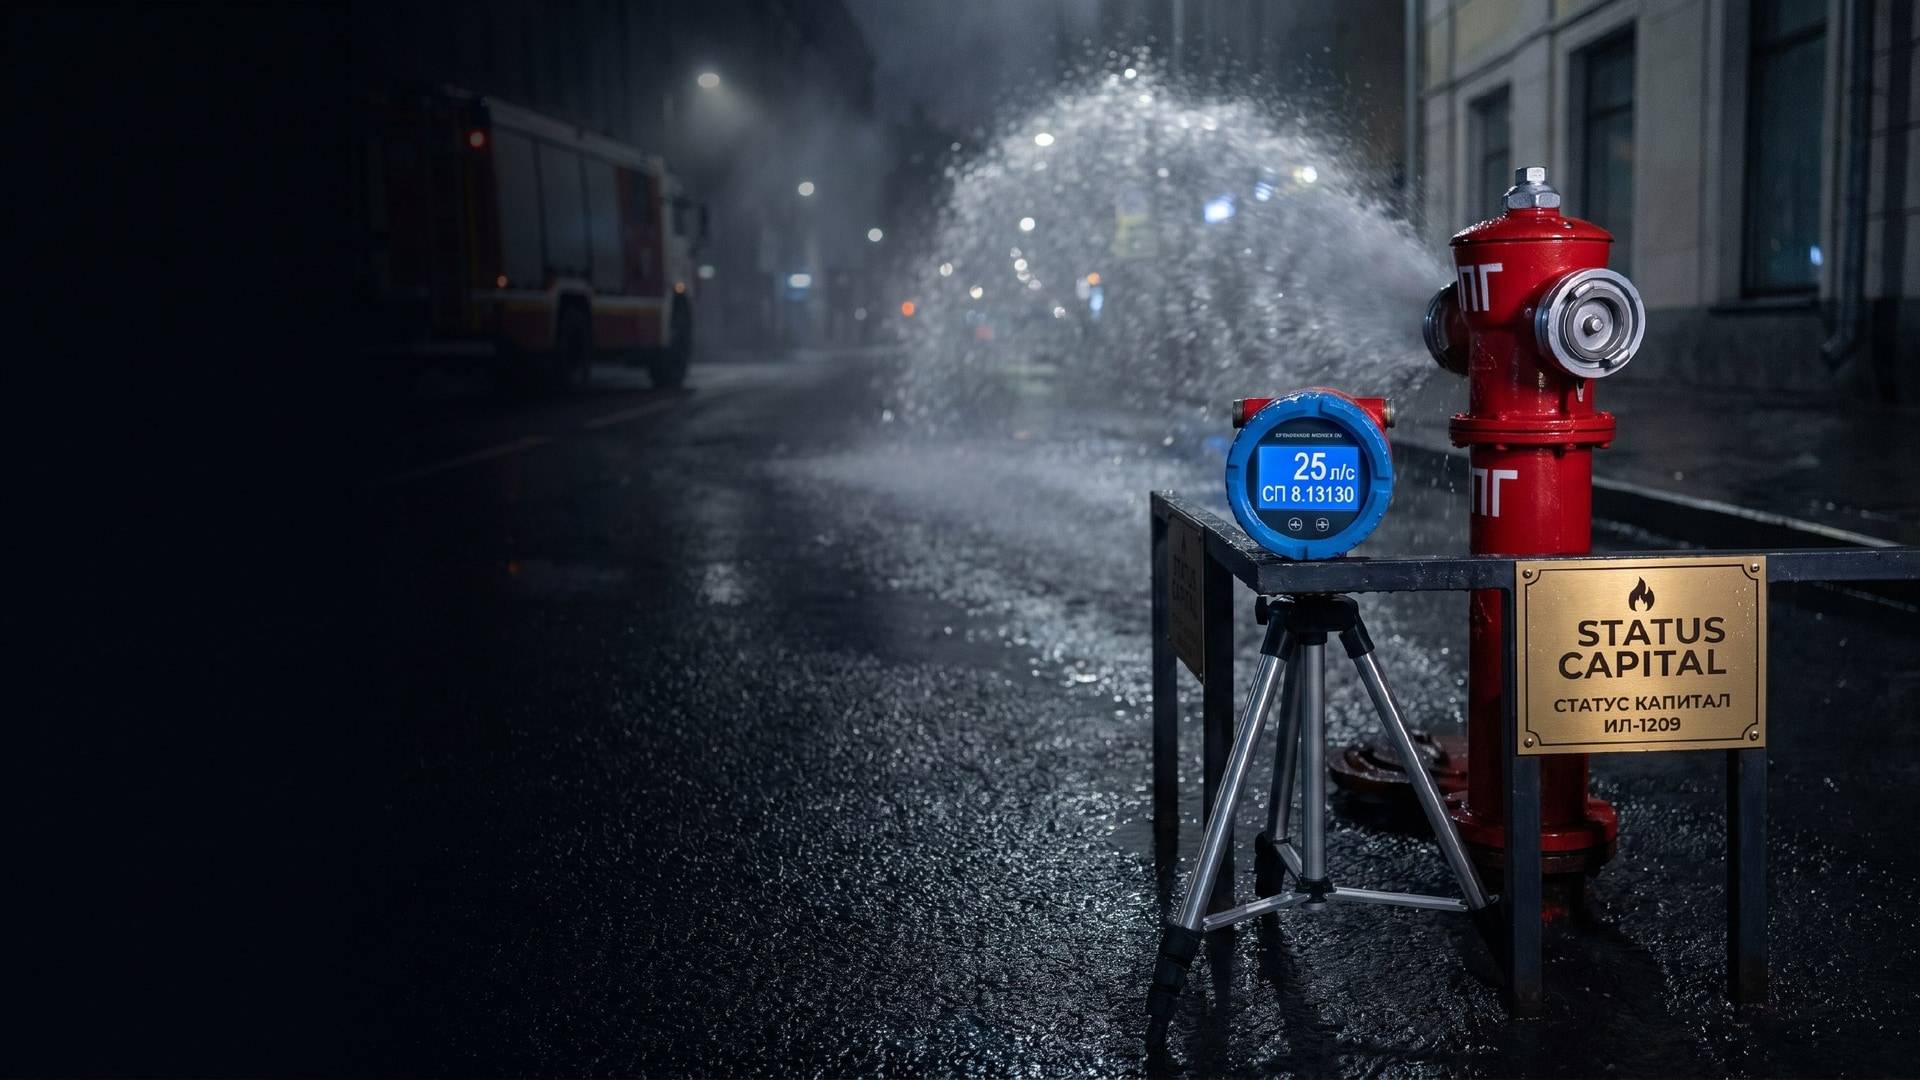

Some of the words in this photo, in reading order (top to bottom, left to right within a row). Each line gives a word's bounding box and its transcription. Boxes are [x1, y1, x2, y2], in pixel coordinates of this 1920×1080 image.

[1293, 452, 1327, 481] 25
[1329, 463, 1355, 481] л/с
[1262, 485, 1286, 502] СП
[1291, 485, 1354, 503] 8.13130
[1577, 616, 1726, 647] STATUS
[1558, 648, 1728, 680] CAPITAL
[1553, 696, 1630, 713] СТАТУС
[1635, 693, 1731, 711] КАПИТАЛ
[1604, 717, 1681, 733] ИЛ-1209
